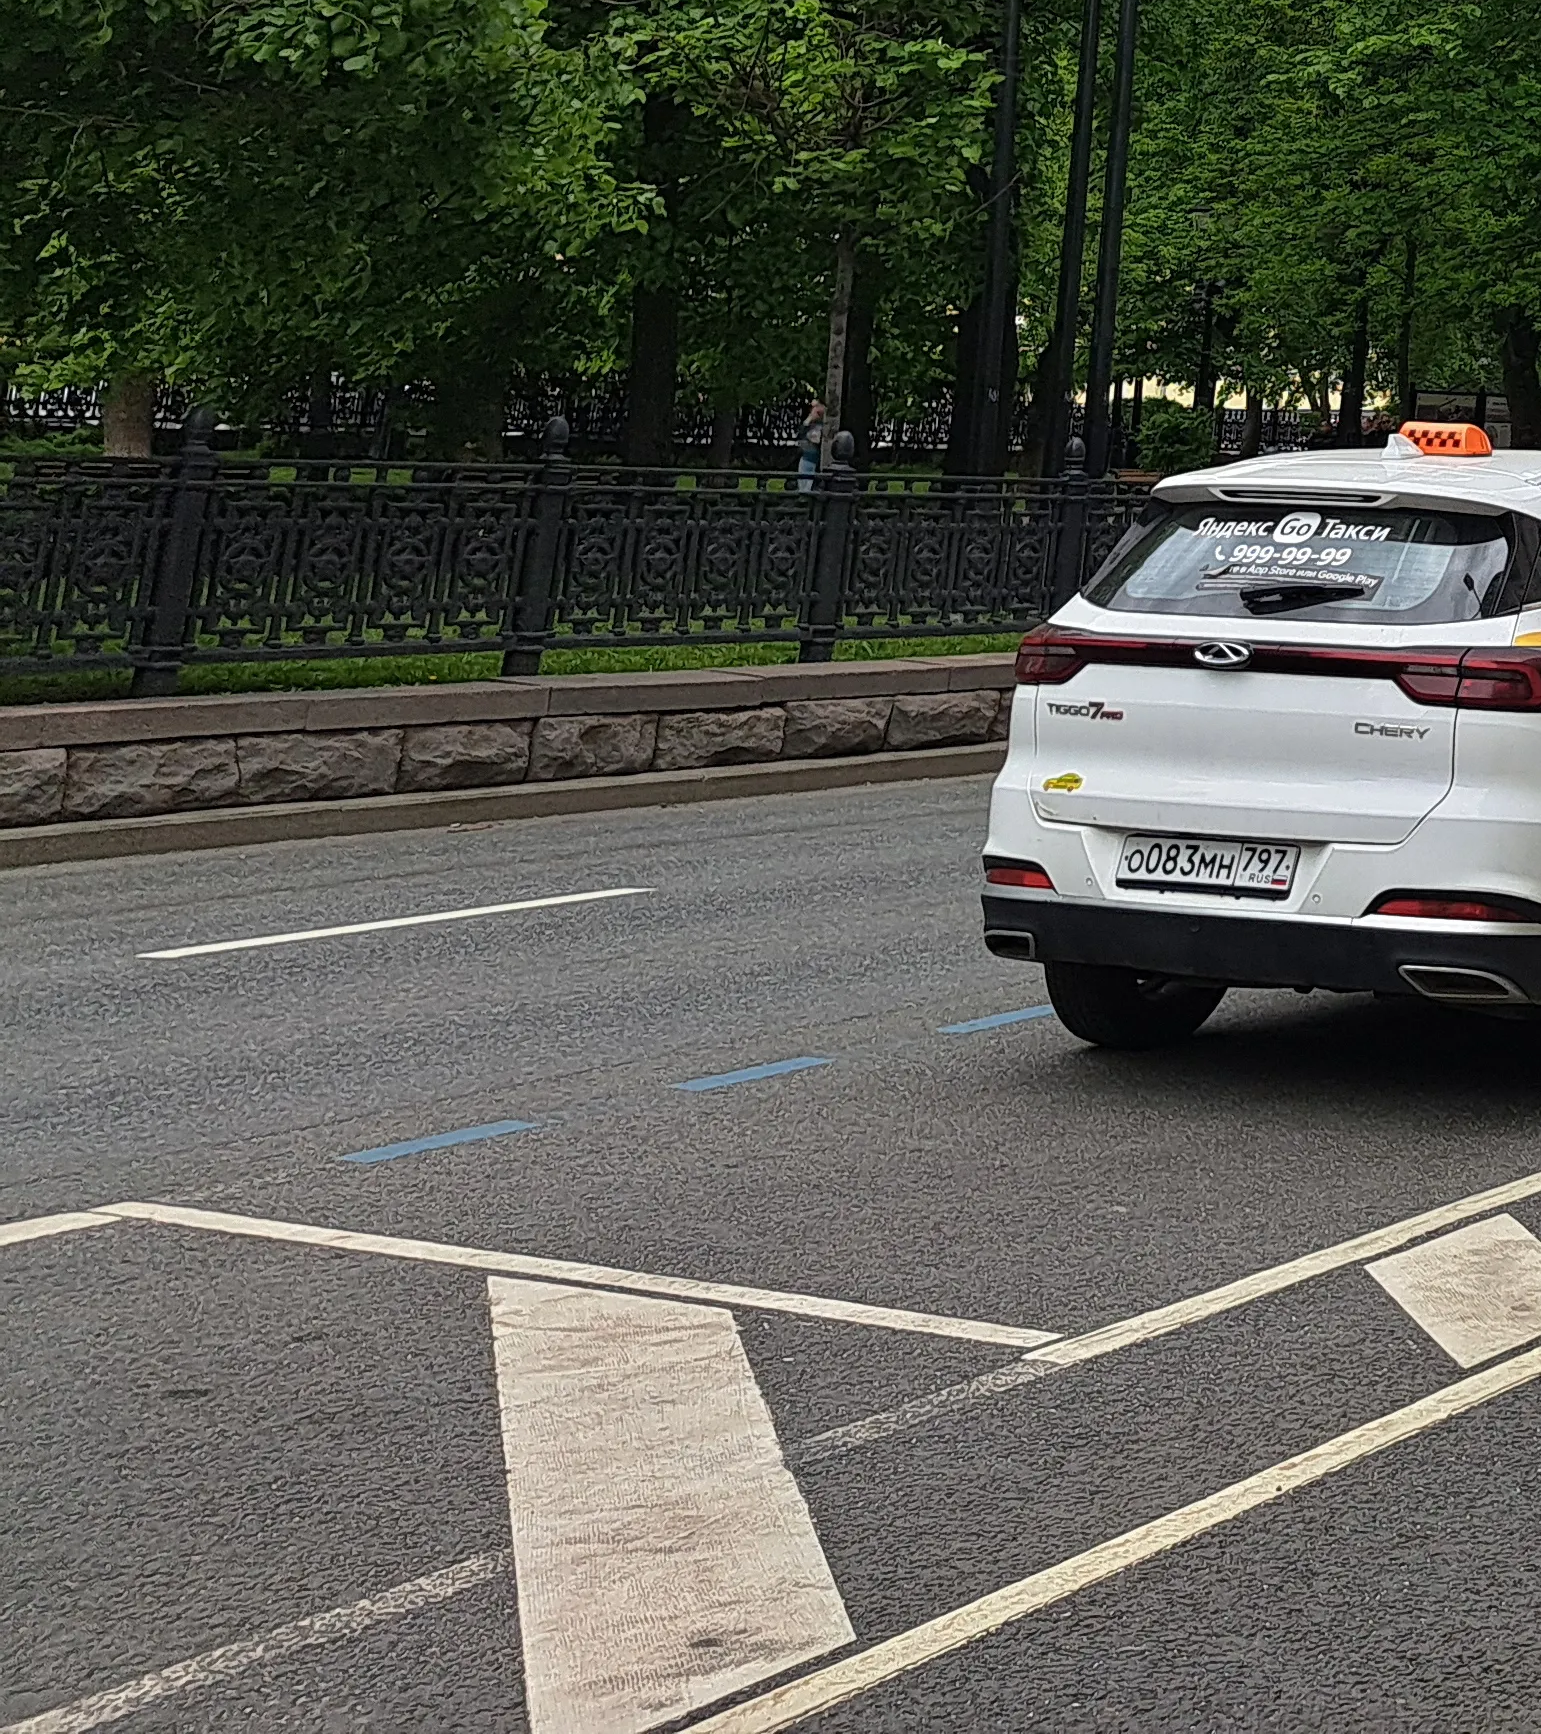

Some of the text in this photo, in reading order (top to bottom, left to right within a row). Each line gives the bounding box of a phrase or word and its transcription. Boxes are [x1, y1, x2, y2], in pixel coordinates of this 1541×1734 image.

[1193, 517, 1275, 539] Яндекс
[1320, 518, 1392, 542] Такси
[1228, 544, 1353, 566] 999-99-99
[1246, 565, 1268, 576] App
[1268, 565, 1294, 577] Store
[1317, 569, 1355, 584] Google
[1355, 573, 1379, 588] Play
[1354, 722, 1431, 740] CHERY
[1127, 842, 1289, 880] О083МН 797
[1248, 873, 1272, 884] RUS
